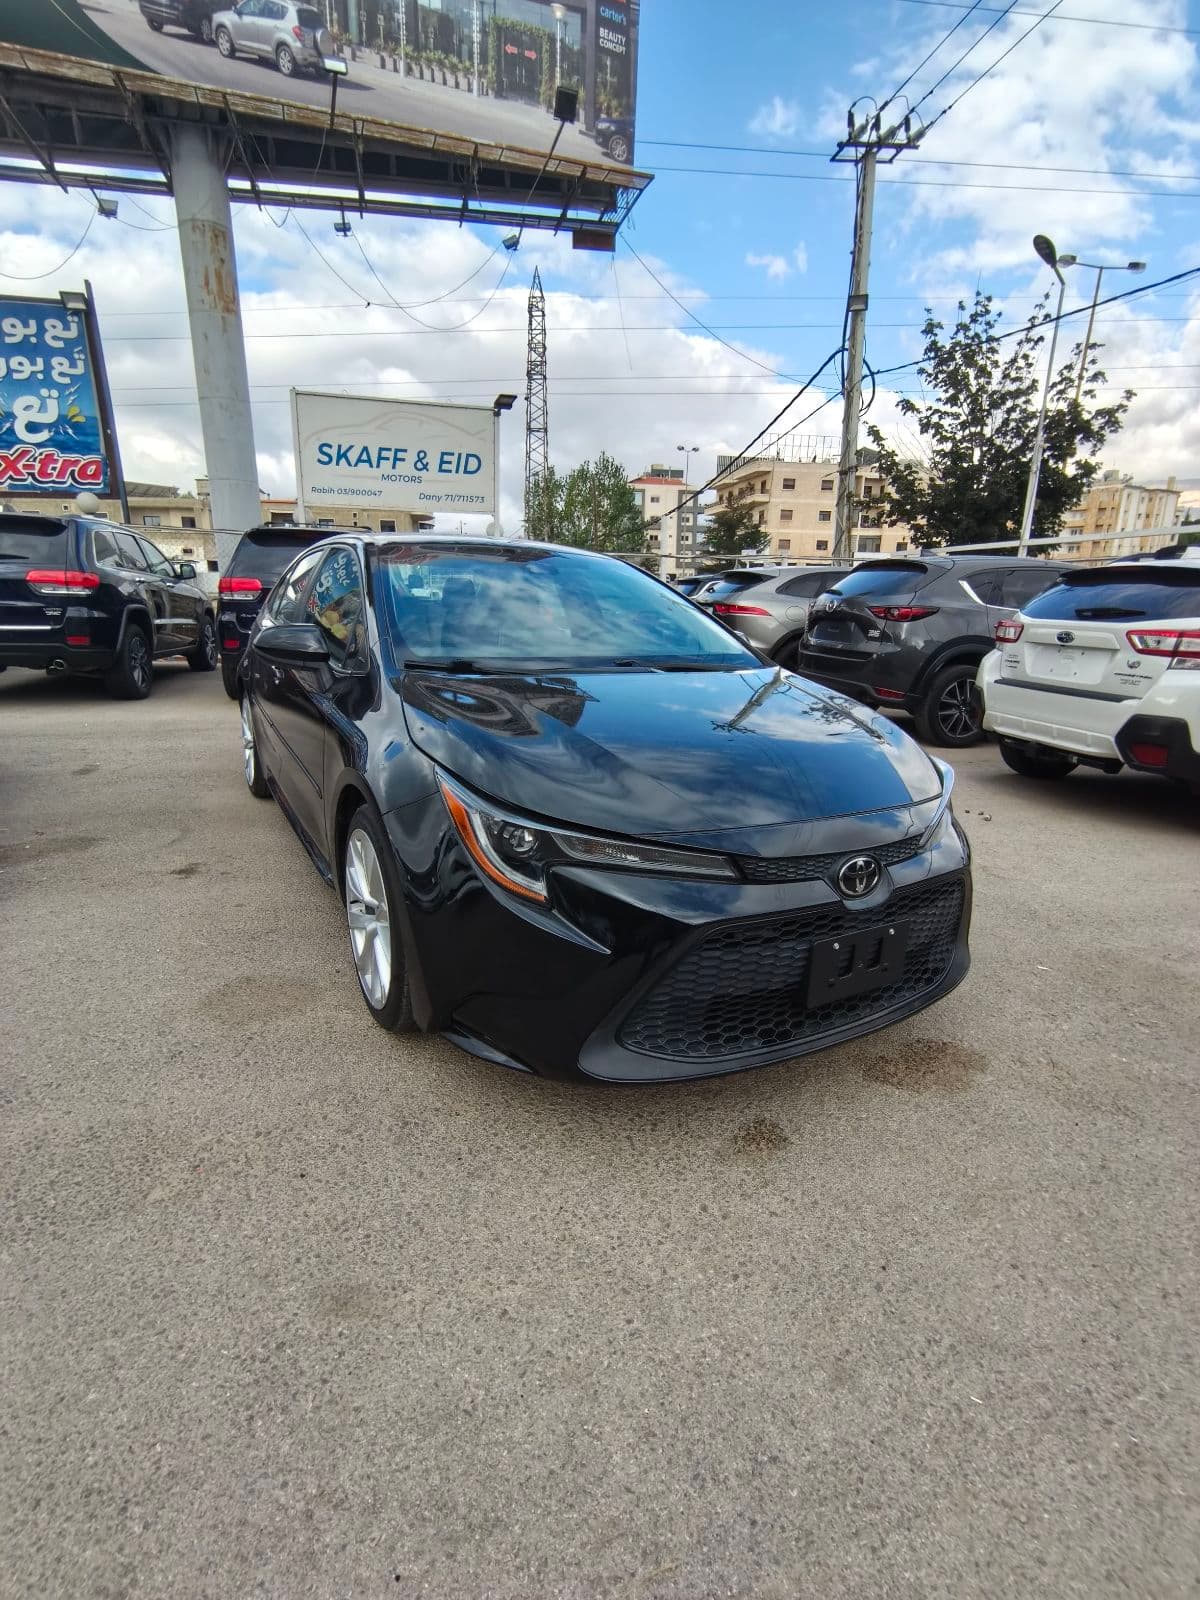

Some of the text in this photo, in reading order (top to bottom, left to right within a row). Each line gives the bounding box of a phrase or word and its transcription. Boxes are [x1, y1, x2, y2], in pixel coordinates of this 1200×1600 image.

[600, 6, 626, 26] carter's
[599, 27, 626, 45] BEAUTY
[599, 38, 626, 55] CONCEPT
[316, 442, 482, 475] SKAFF & EID
[381, 473, 423, 484] MOTORS
[311, 486, 383, 497] Rabih 03/900047
[418, 492, 485, 504] Dany 71/711573
